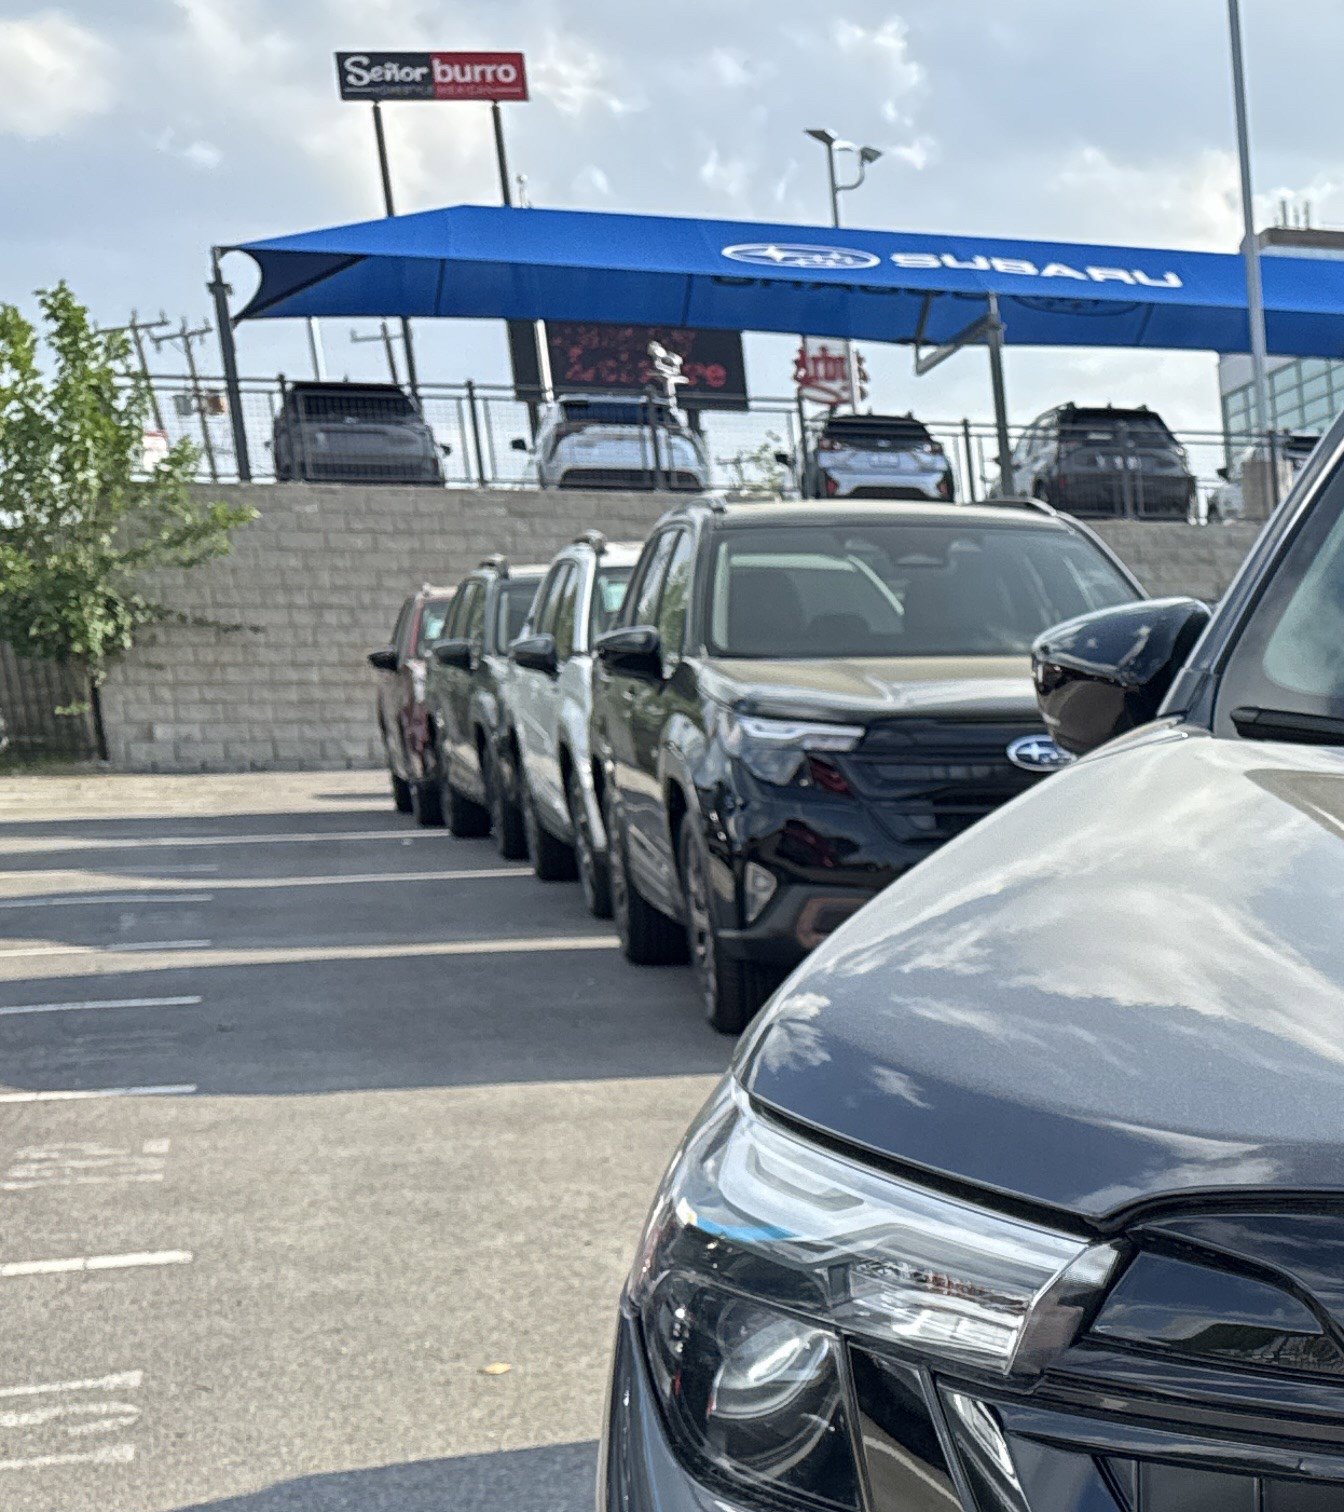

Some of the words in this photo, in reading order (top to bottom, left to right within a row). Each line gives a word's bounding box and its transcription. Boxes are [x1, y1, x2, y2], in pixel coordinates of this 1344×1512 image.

[344, 55, 429, 86] Señor
[432, 58, 517, 83] burro
[889, 251, 1183, 288] SUBARU
